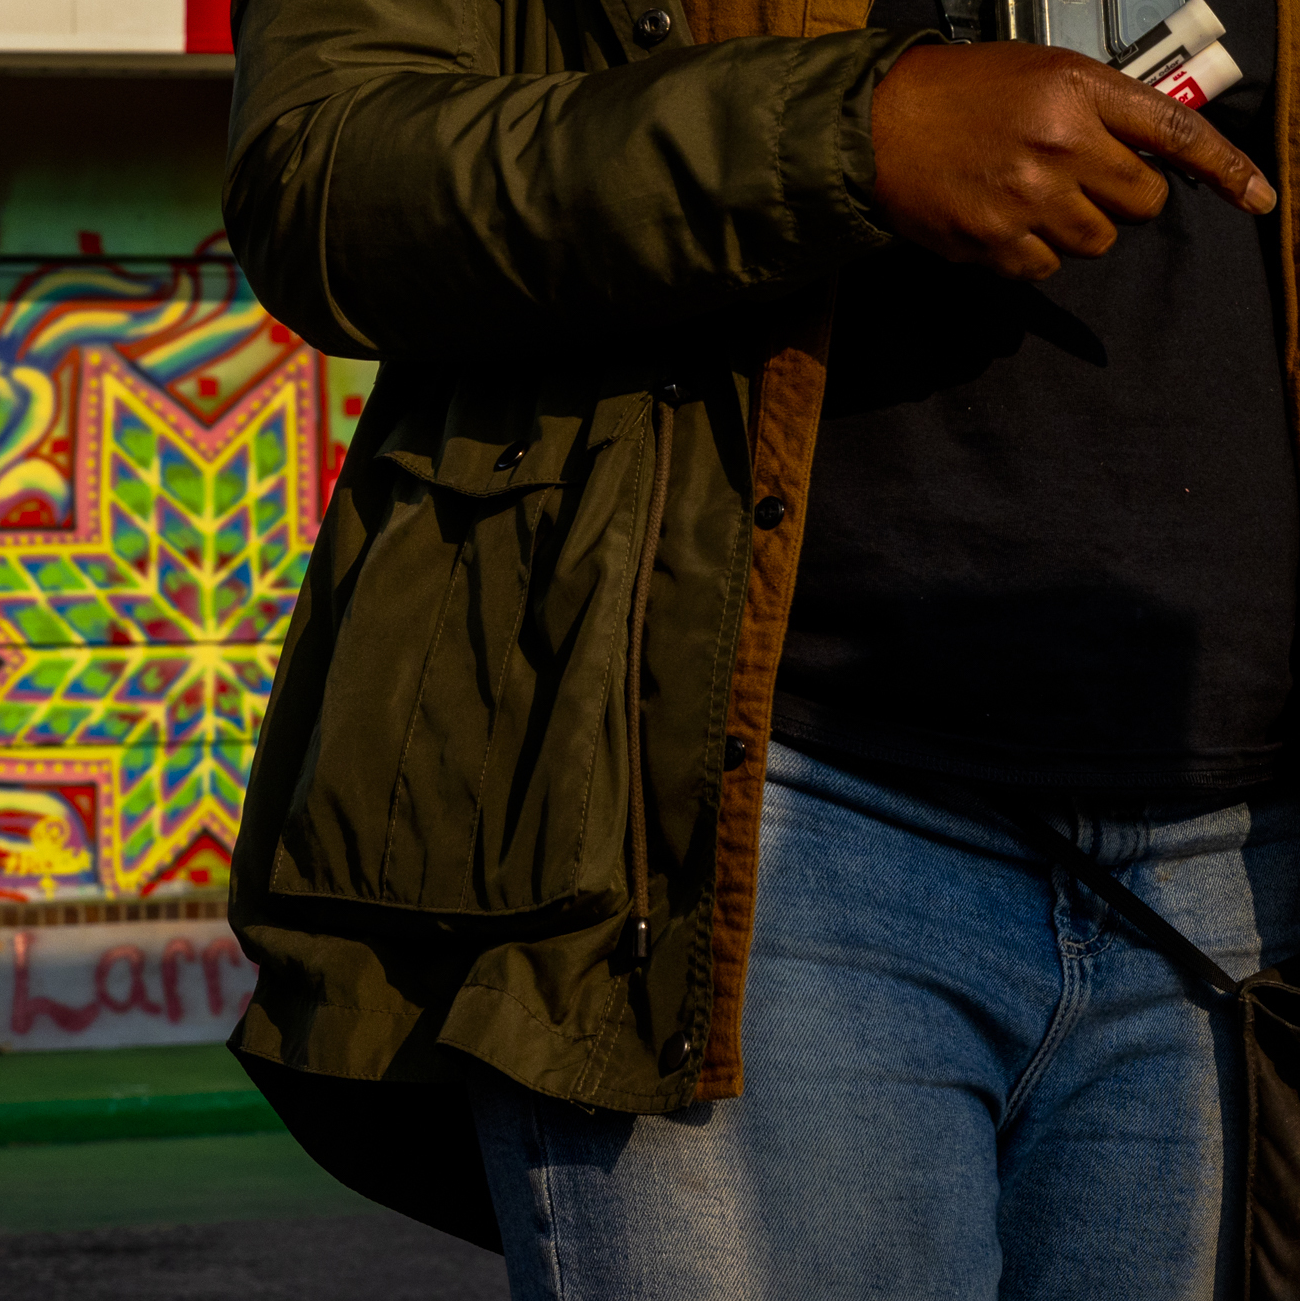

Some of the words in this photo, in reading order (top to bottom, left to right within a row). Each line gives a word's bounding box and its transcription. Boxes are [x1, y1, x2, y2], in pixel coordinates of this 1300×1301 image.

[1158, 59, 1181, 77] odor
[1176, 91, 1189, 103] or
[9, 931, 260, 1035] Larr
